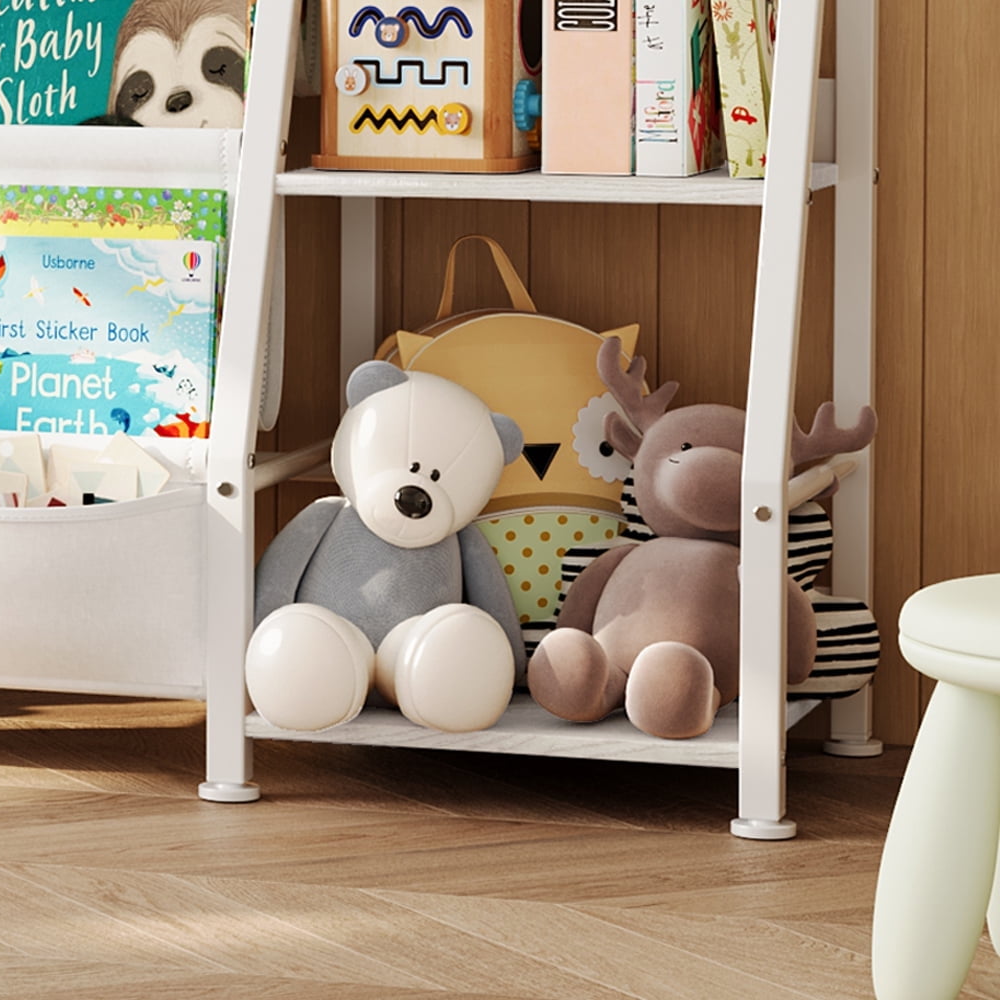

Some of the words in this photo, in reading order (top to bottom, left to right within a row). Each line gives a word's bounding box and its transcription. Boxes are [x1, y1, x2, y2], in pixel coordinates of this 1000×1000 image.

[13, 10, 103, 78] Baby
[41, 254, 96, 271] Usborne
[36, 320, 99, 341] Sticker
[107, 322, 150, 343] Book
[10, 361, 118, 400] Planet
[15, 406, 108, 433] Earth
